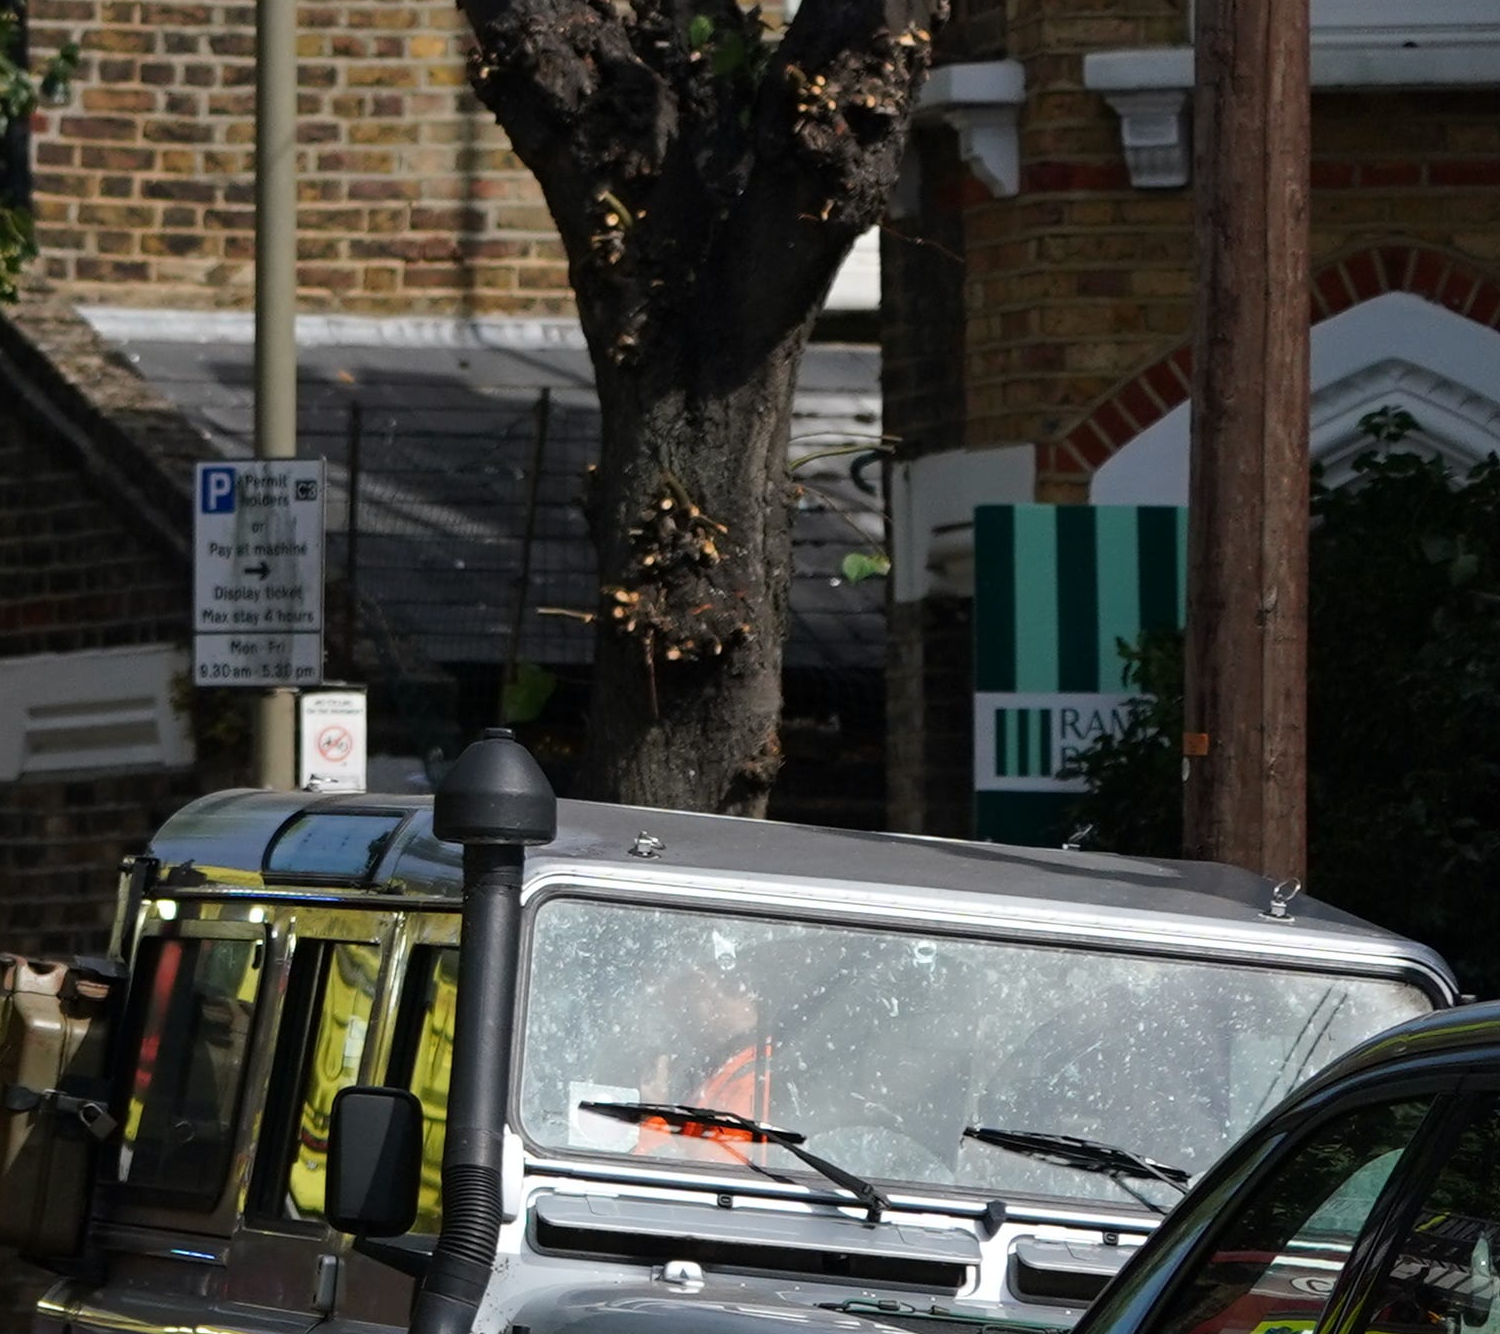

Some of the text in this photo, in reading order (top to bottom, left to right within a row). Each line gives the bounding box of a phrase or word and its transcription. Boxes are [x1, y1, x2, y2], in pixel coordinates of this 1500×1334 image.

[210, 472, 288, 510] P Permit
[210, 543, 232, 559] Pay
[255, 542, 307, 555] machine
[215, 585, 302, 603] Display ticket
[203, 610, 228, 622] Max
[234, 610, 259, 625] stay
[278, 610, 314, 623] hours
[231, 641, 257, 653] Mon
[269, 642, 284, 653] Fri
